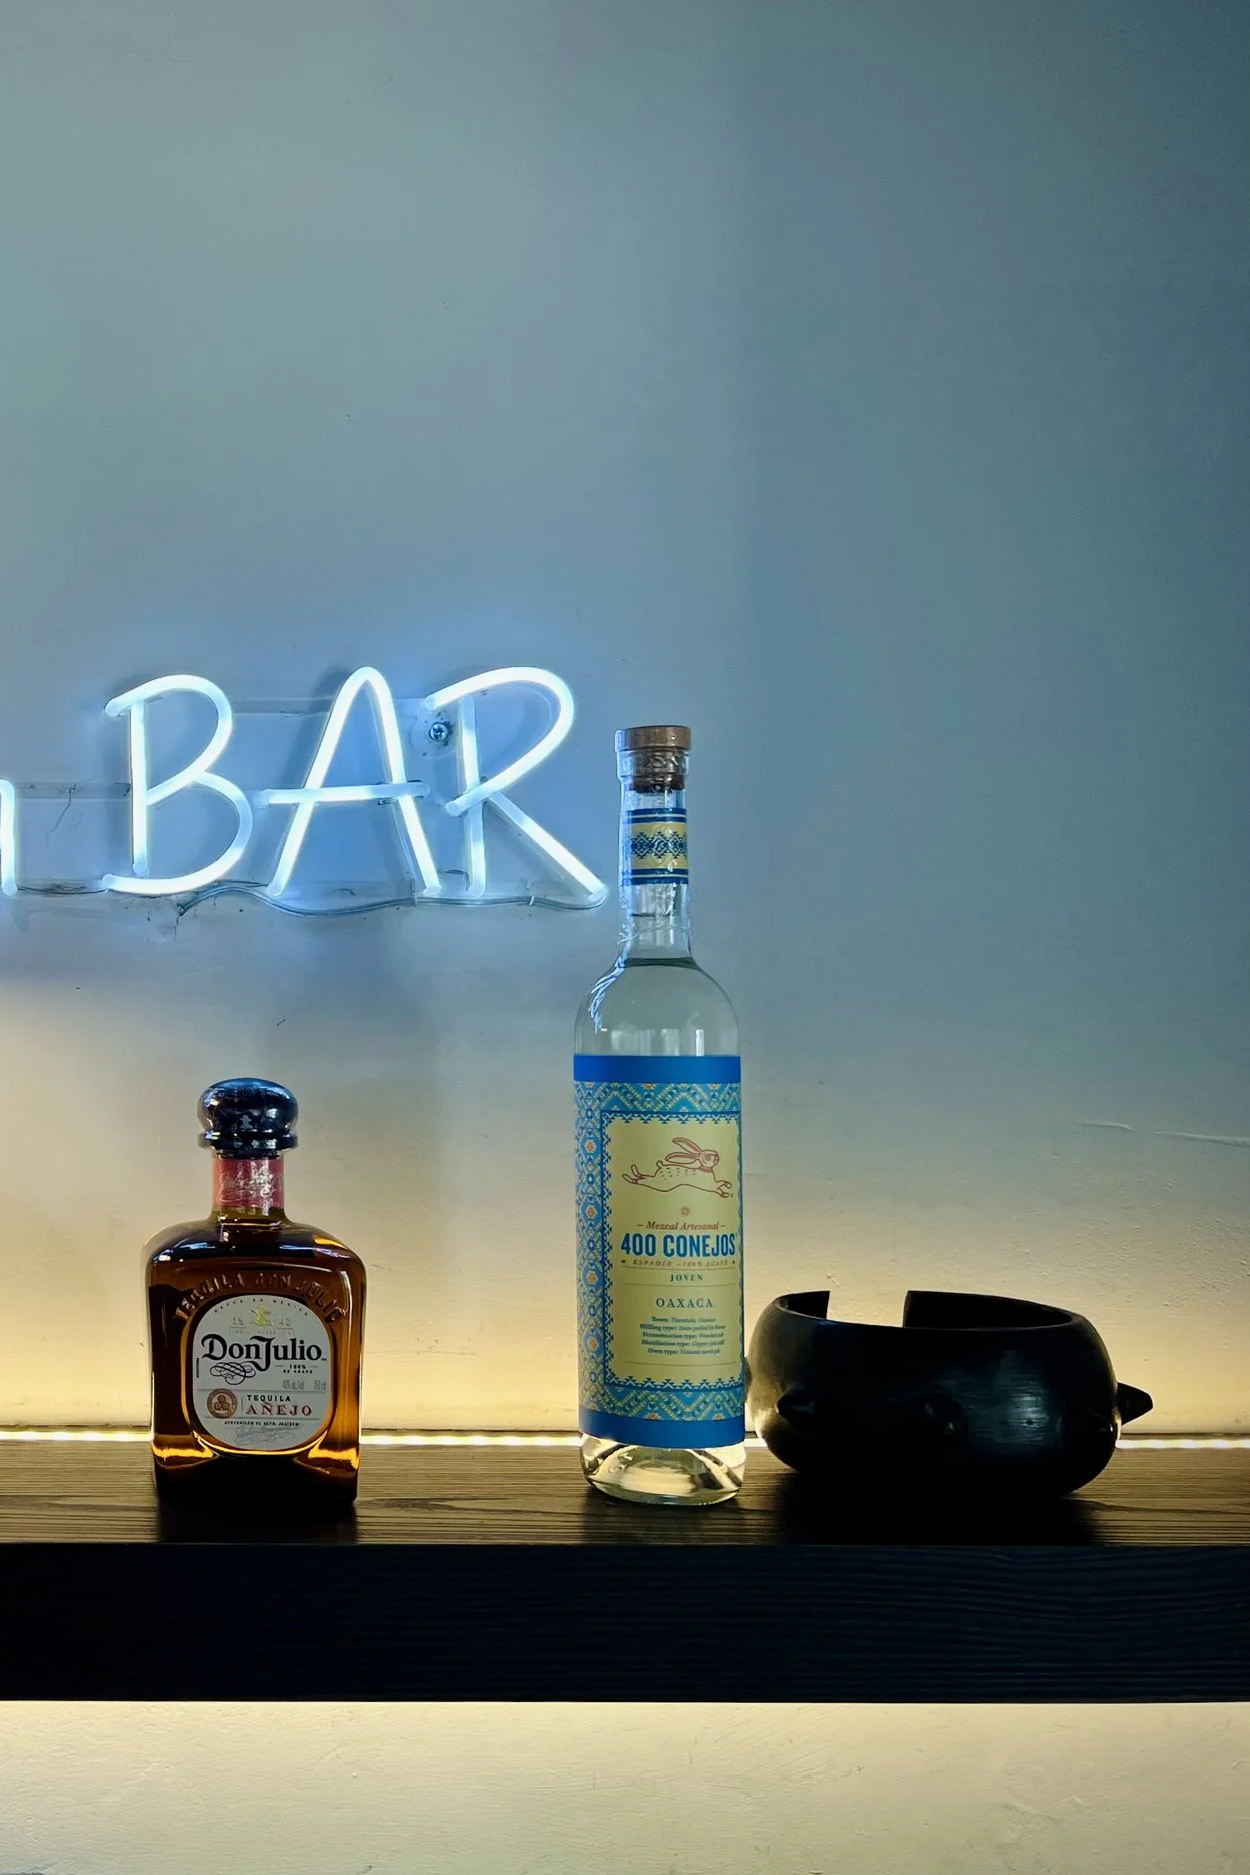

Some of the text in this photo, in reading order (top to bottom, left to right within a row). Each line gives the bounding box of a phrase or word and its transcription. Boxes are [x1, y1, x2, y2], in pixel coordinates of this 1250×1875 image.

[103, 664, 610, 907] BAR
[646, 1221, 719, 1231] Mezcal Artesanal
[621, 1232, 736, 1258] 400 CONEJOS
[670, 1274, 703, 1282] JOVEN
[656, 1297, 714, 1309] OAXACA
[247, 1394, 291, 1403] TEQUILA
[246, 1402, 313, 1417] AÑEJO
